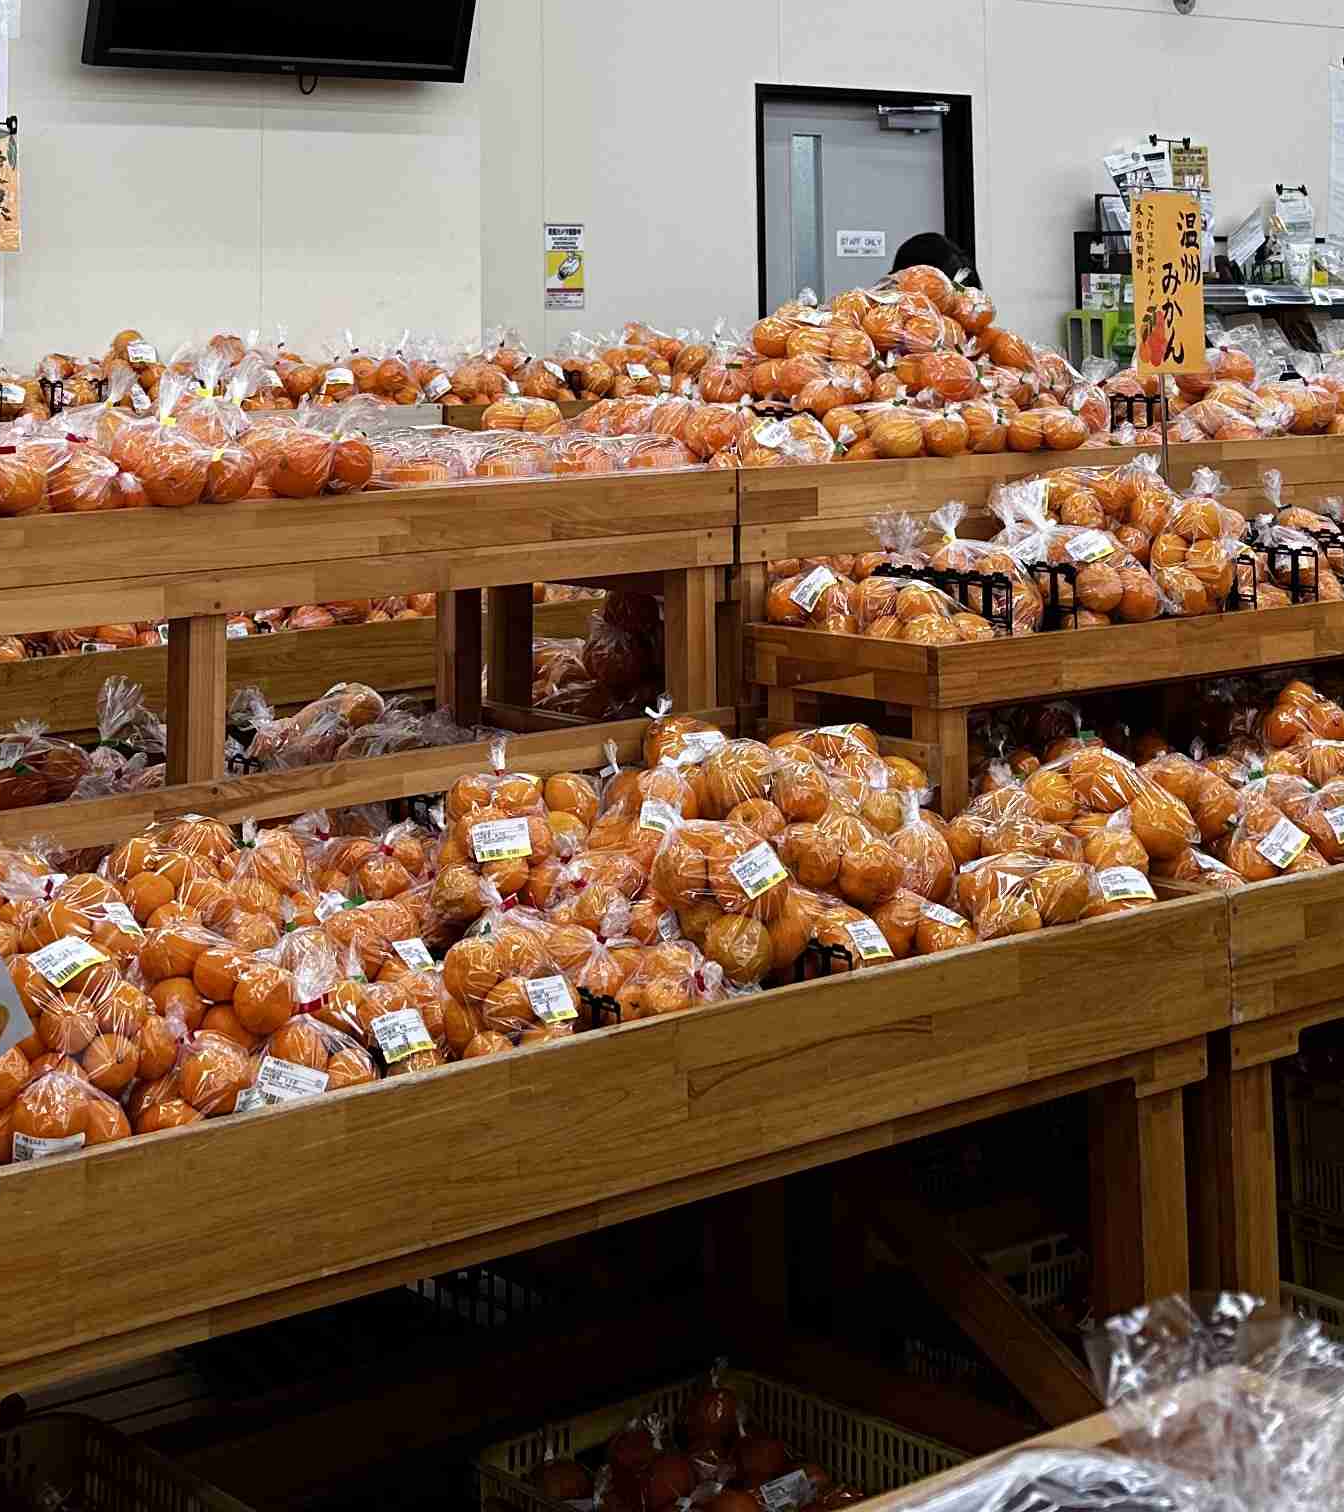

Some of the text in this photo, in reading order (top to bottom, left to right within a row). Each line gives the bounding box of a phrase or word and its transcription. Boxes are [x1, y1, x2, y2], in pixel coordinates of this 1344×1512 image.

[1176, 210, 1201, 286] 温州
[1161, 261, 1185, 365] みかん
